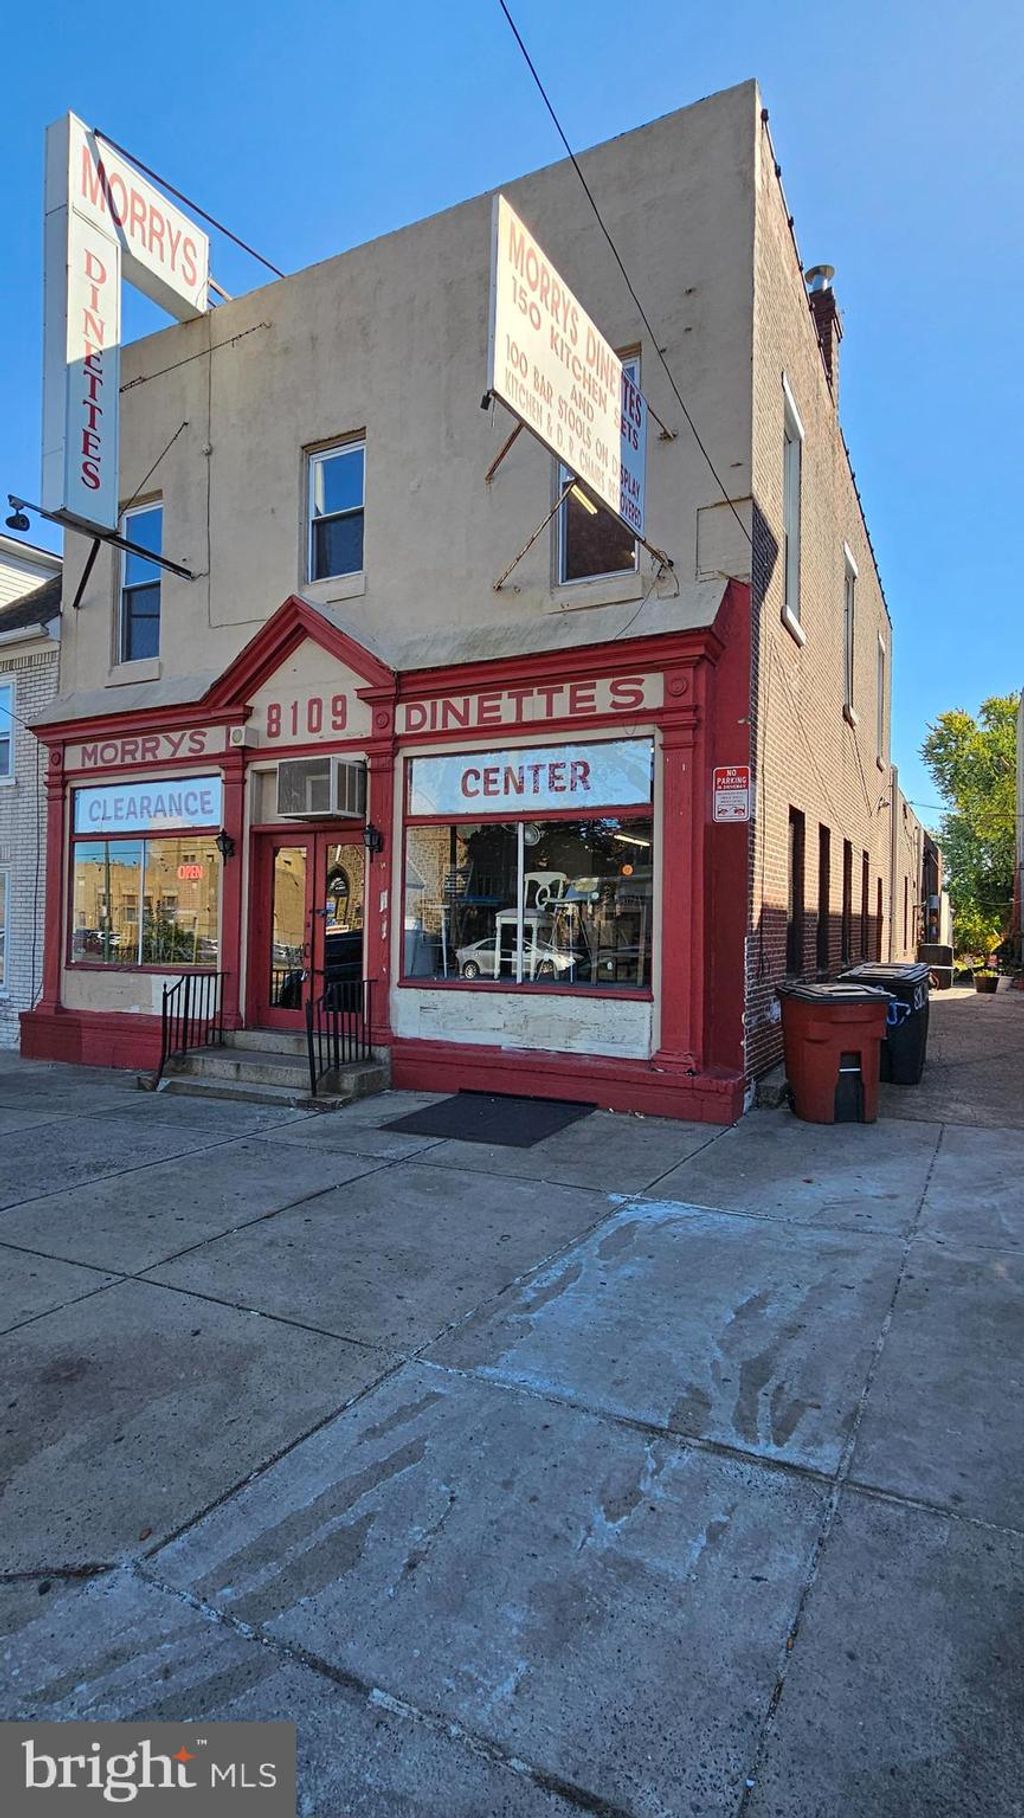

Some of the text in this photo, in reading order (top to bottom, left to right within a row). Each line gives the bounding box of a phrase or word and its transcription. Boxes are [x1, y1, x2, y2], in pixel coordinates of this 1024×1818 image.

[82, 145, 198, 287] MORRYS
[509, 218, 580, 347] MORRYS
[512, 275, 541, 331] 150
[550, 325, 608, 414] KITCHEN
[81, 248, 108, 491] DINETTES
[505, 366, 543, 428] KITCHEN
[506, 333, 528, 378] 100
[534, 365, 553, 408] BAR
[558, 395, 592, 449] STOOLS
[595, 438, 609, 468] ON
[570, 384, 595, 422] AND
[267, 694, 347, 739] 8109
[404, 676, 646, 732] DINETTES
[81, 730, 208, 767] MORRYS
[461, 760, 592, 798] CENTER
[716, 776, 747, 785] PARKING
[726, 769, 737, 777] NO
[88, 790, 215, 822] CLEARANCE
[177, 865, 203, 880] OPEN
